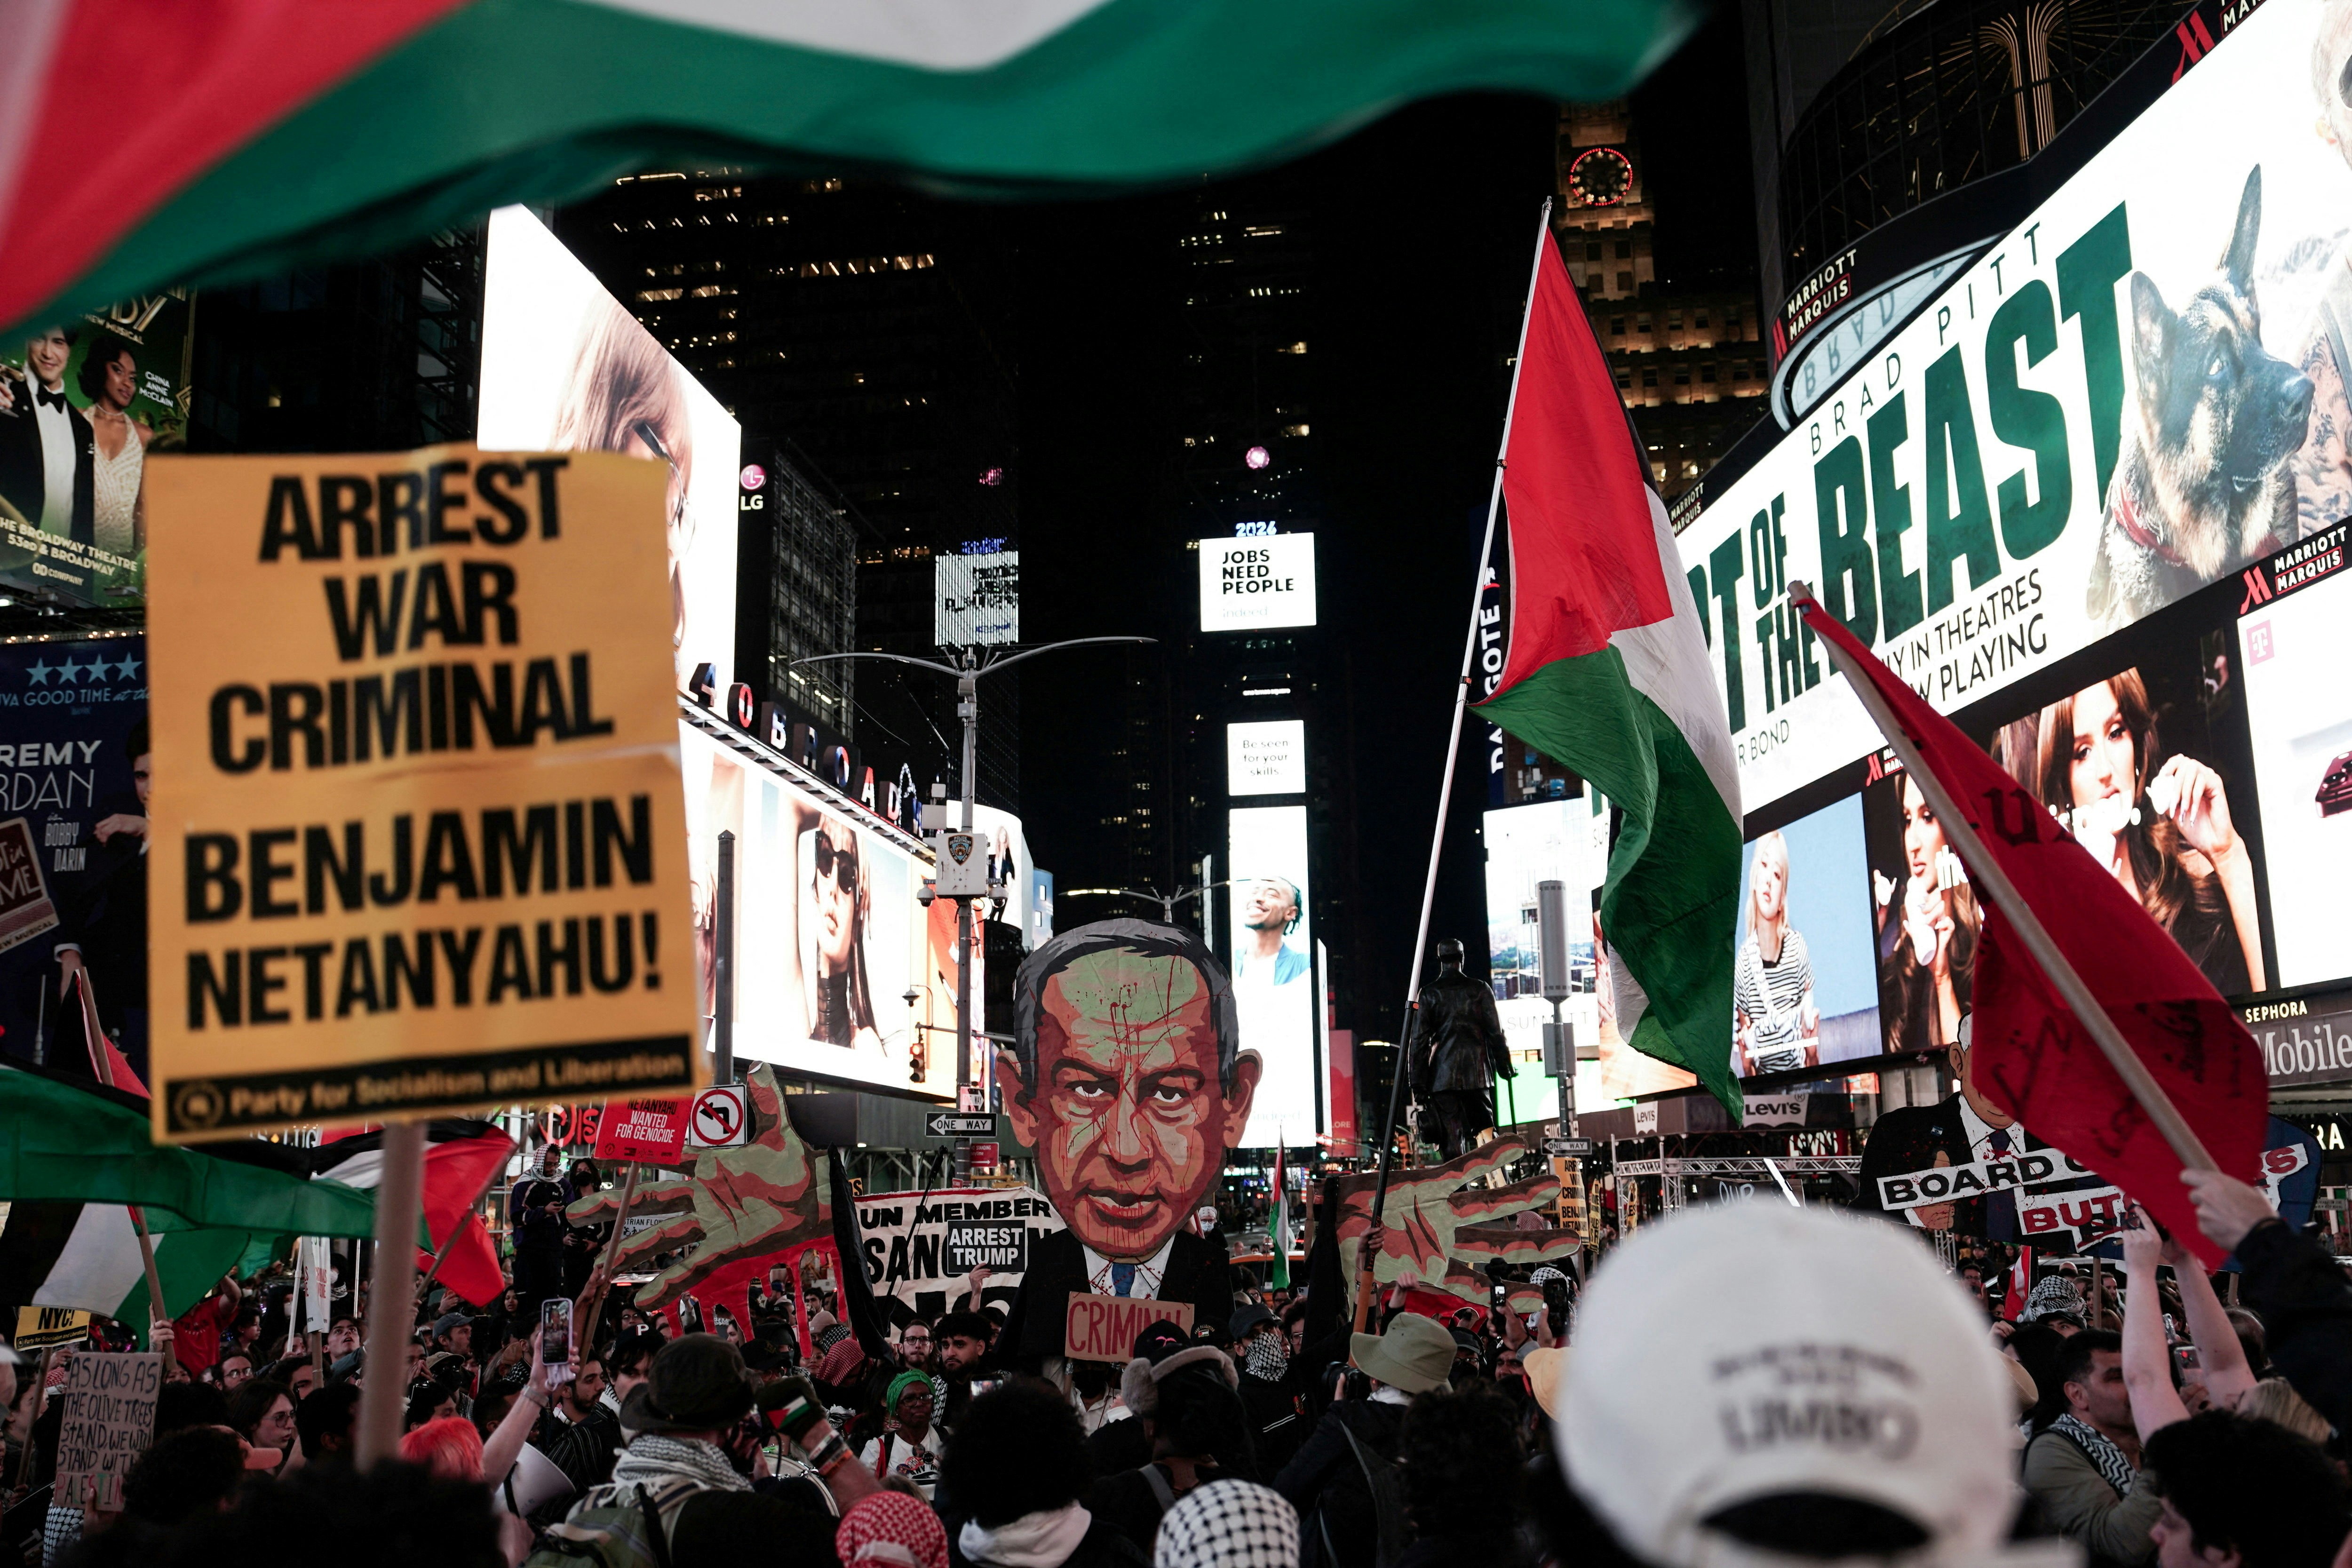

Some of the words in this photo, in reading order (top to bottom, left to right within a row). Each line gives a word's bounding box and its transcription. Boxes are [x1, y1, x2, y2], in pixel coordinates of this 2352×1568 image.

[2224, 0, 2257, 31] MA
[1788, 249, 1856, 319] MARRIOTT
[1790, 279, 1848, 341] MARQUIS
[1811, 352, 1902, 457] BRAD
[1938, 222, 2041, 346] PITT
[145, 370, 170, 389] CHINA
[145, 382, 168, 397] ANNE
[1814, 200, 2133, 676] BEAST
[258, 457, 570, 563] ARREST
[740, 494, 763, 510] LG
[1671, 482, 1704, 521] MARRIOTT
[1235, 520, 1277, 537] 2026
[1672, 501, 1702, 535] MARQUIS
[8, 533, 37, 551] 53RD
[39, 543, 48, 556] &
[51, 546, 116, 576] BROADWAY
[19, 524, 87, 554] BROADWAY
[87, 546, 138, 572] THEATRE
[1222, 549, 1270, 565] JOBS
[1751, 490, 1788, 611] OF
[2274, 525, 2347, 573] MARRIOTT
[47, 567, 84, 586] COMPANY
[1223, 565, 1270, 580] NEED
[2277, 550, 2341, 591] MARQUIS
[1223, 578, 1294, 595] PEOPLE
[322, 560, 520, 663] WAR
[1223, 605, 1268, 618] indeed
[1911, 633, 1930, 670] IN
[1934, 568, 2042, 656] THEATRES
[1941, 613, 2048, 701] PLAYING
[24, 690, 75, 707] GOOD
[79, 688, 111, 703] TIME
[208, 652, 616, 776] CRIMINAL
[1243, 740, 1257, 748] Be
[1750, 719, 1790, 760] BOND
[1250, 766, 1283, 776] skills.
[1263, 755, 1288, 764] your
[44, 822, 79, 847] BOBBY
[54, 847, 87, 872] DARIN
[185, 793, 653, 925] BENJAMIN
[15, 920, 54, 942] MUSICAL
[185, 910, 663, 1032] NETANYAHU!
[2245, 1000, 2307, 1024] SEPHORA
[229, 1088, 307, 1120] Party
[311, 1079, 350, 1107] for
[355, 1069, 485, 1103] Socialism
[488, 1059, 540, 1090] and
[545, 1051, 684, 1086] Liberation
[627, 1098, 678, 1115] NETANYAHU
[630, 1111, 668, 1129] WANTED
[615, 1123, 632, 1139] FOR
[633, 1126, 676, 1144] GENOCIDE
[937, 1120, 956, 1129] ONE
[966, 1120, 987, 1130] WAY
[1883, 1154, 2054, 1205] BOARD
[860, 1206, 903, 1230] UN
[915, 1198, 1052, 1224] MEMBER
[949, 1227, 1024, 1246] ARREST
[953, 1248, 1019, 1266] TRUMP
[38, 1307, 75, 1330] NYC!
[637, 1324, 649, 1336] P
[68, 1356, 91, 1388] AS
[92, 1358, 130, 1390] LONG
[132, 1360, 159, 1394] AS
[64, 1391, 88, 1418] THE
[87, 1393, 122, 1422] OLIVE
[125, 1398, 154, 1428] TREES
[108, 1429, 128, 1451] WE
[58, 1444, 98, 1472] STAND
[54, 1473, 126, 1505] PALESTIN
